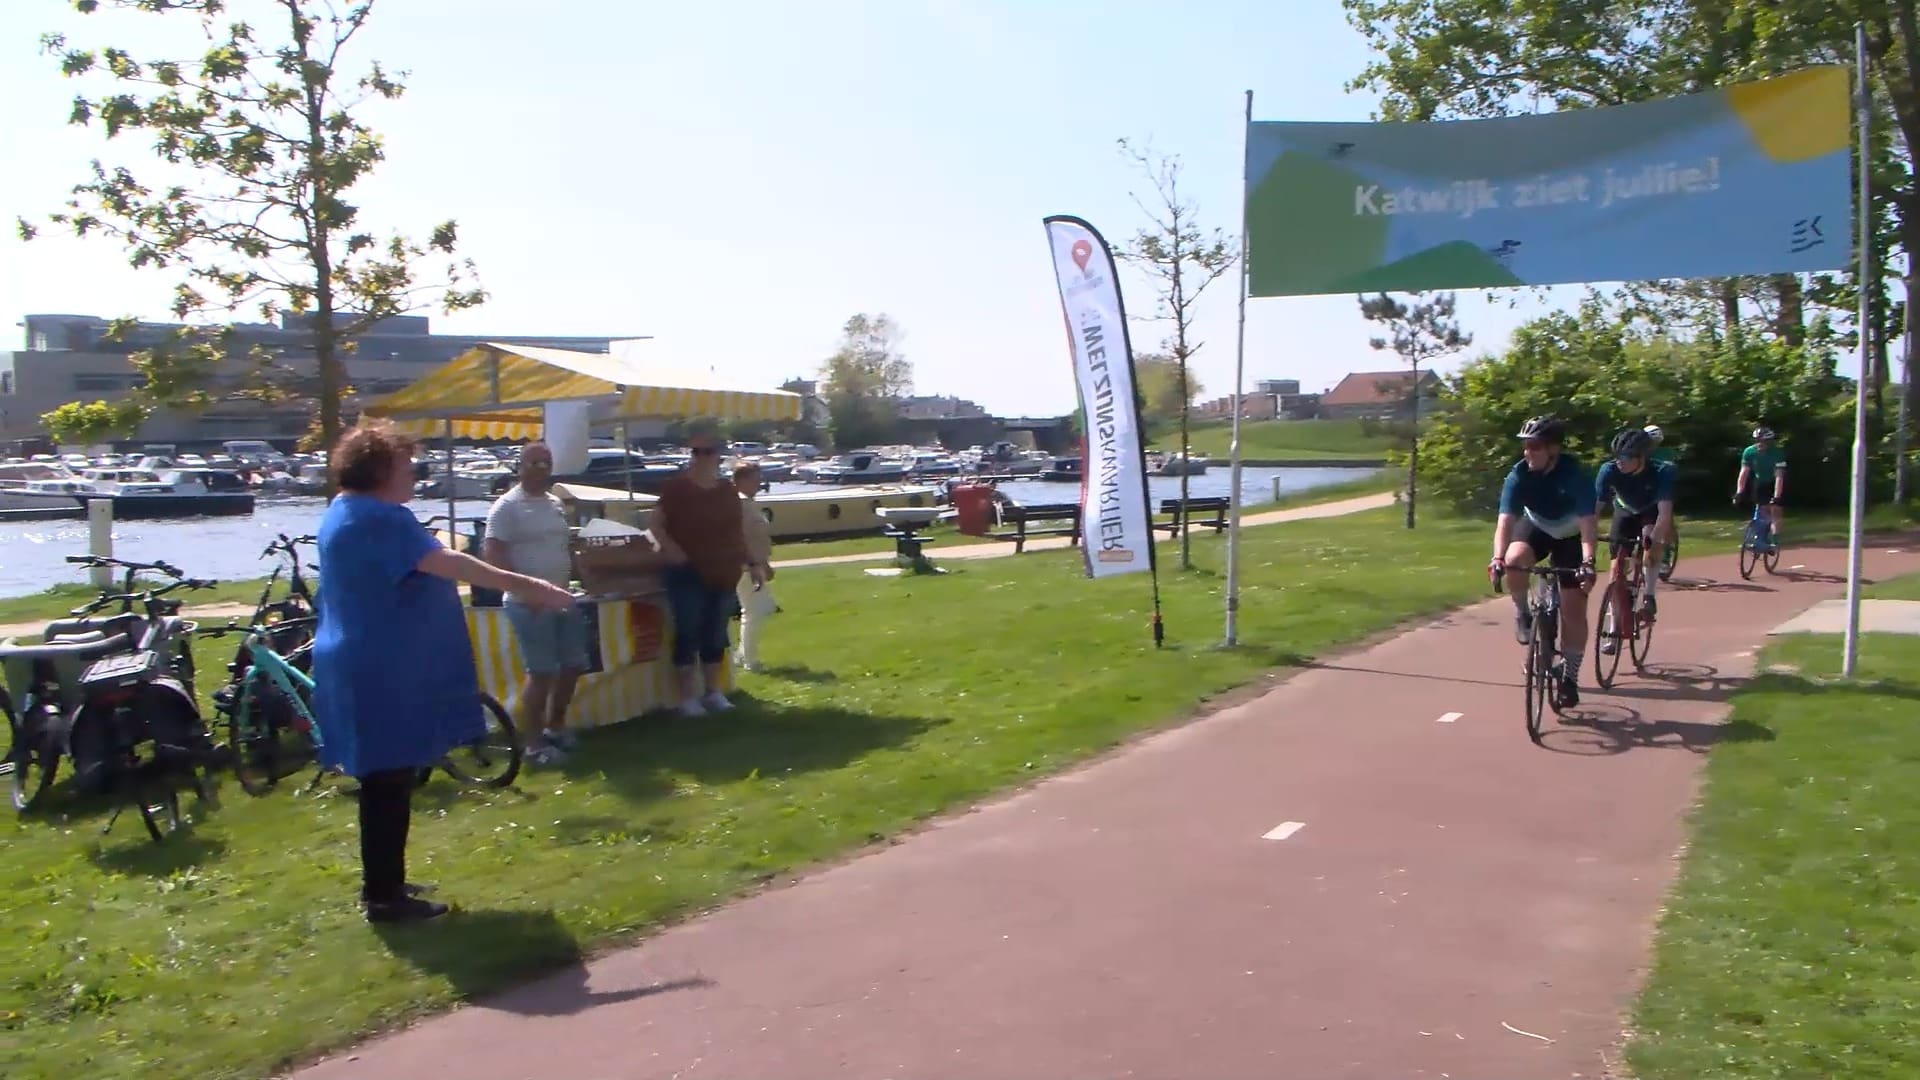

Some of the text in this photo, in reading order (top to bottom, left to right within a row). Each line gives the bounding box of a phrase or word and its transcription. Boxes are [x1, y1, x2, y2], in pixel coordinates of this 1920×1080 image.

[1353, 156, 1720, 219] Katwijk ziet jullie!
